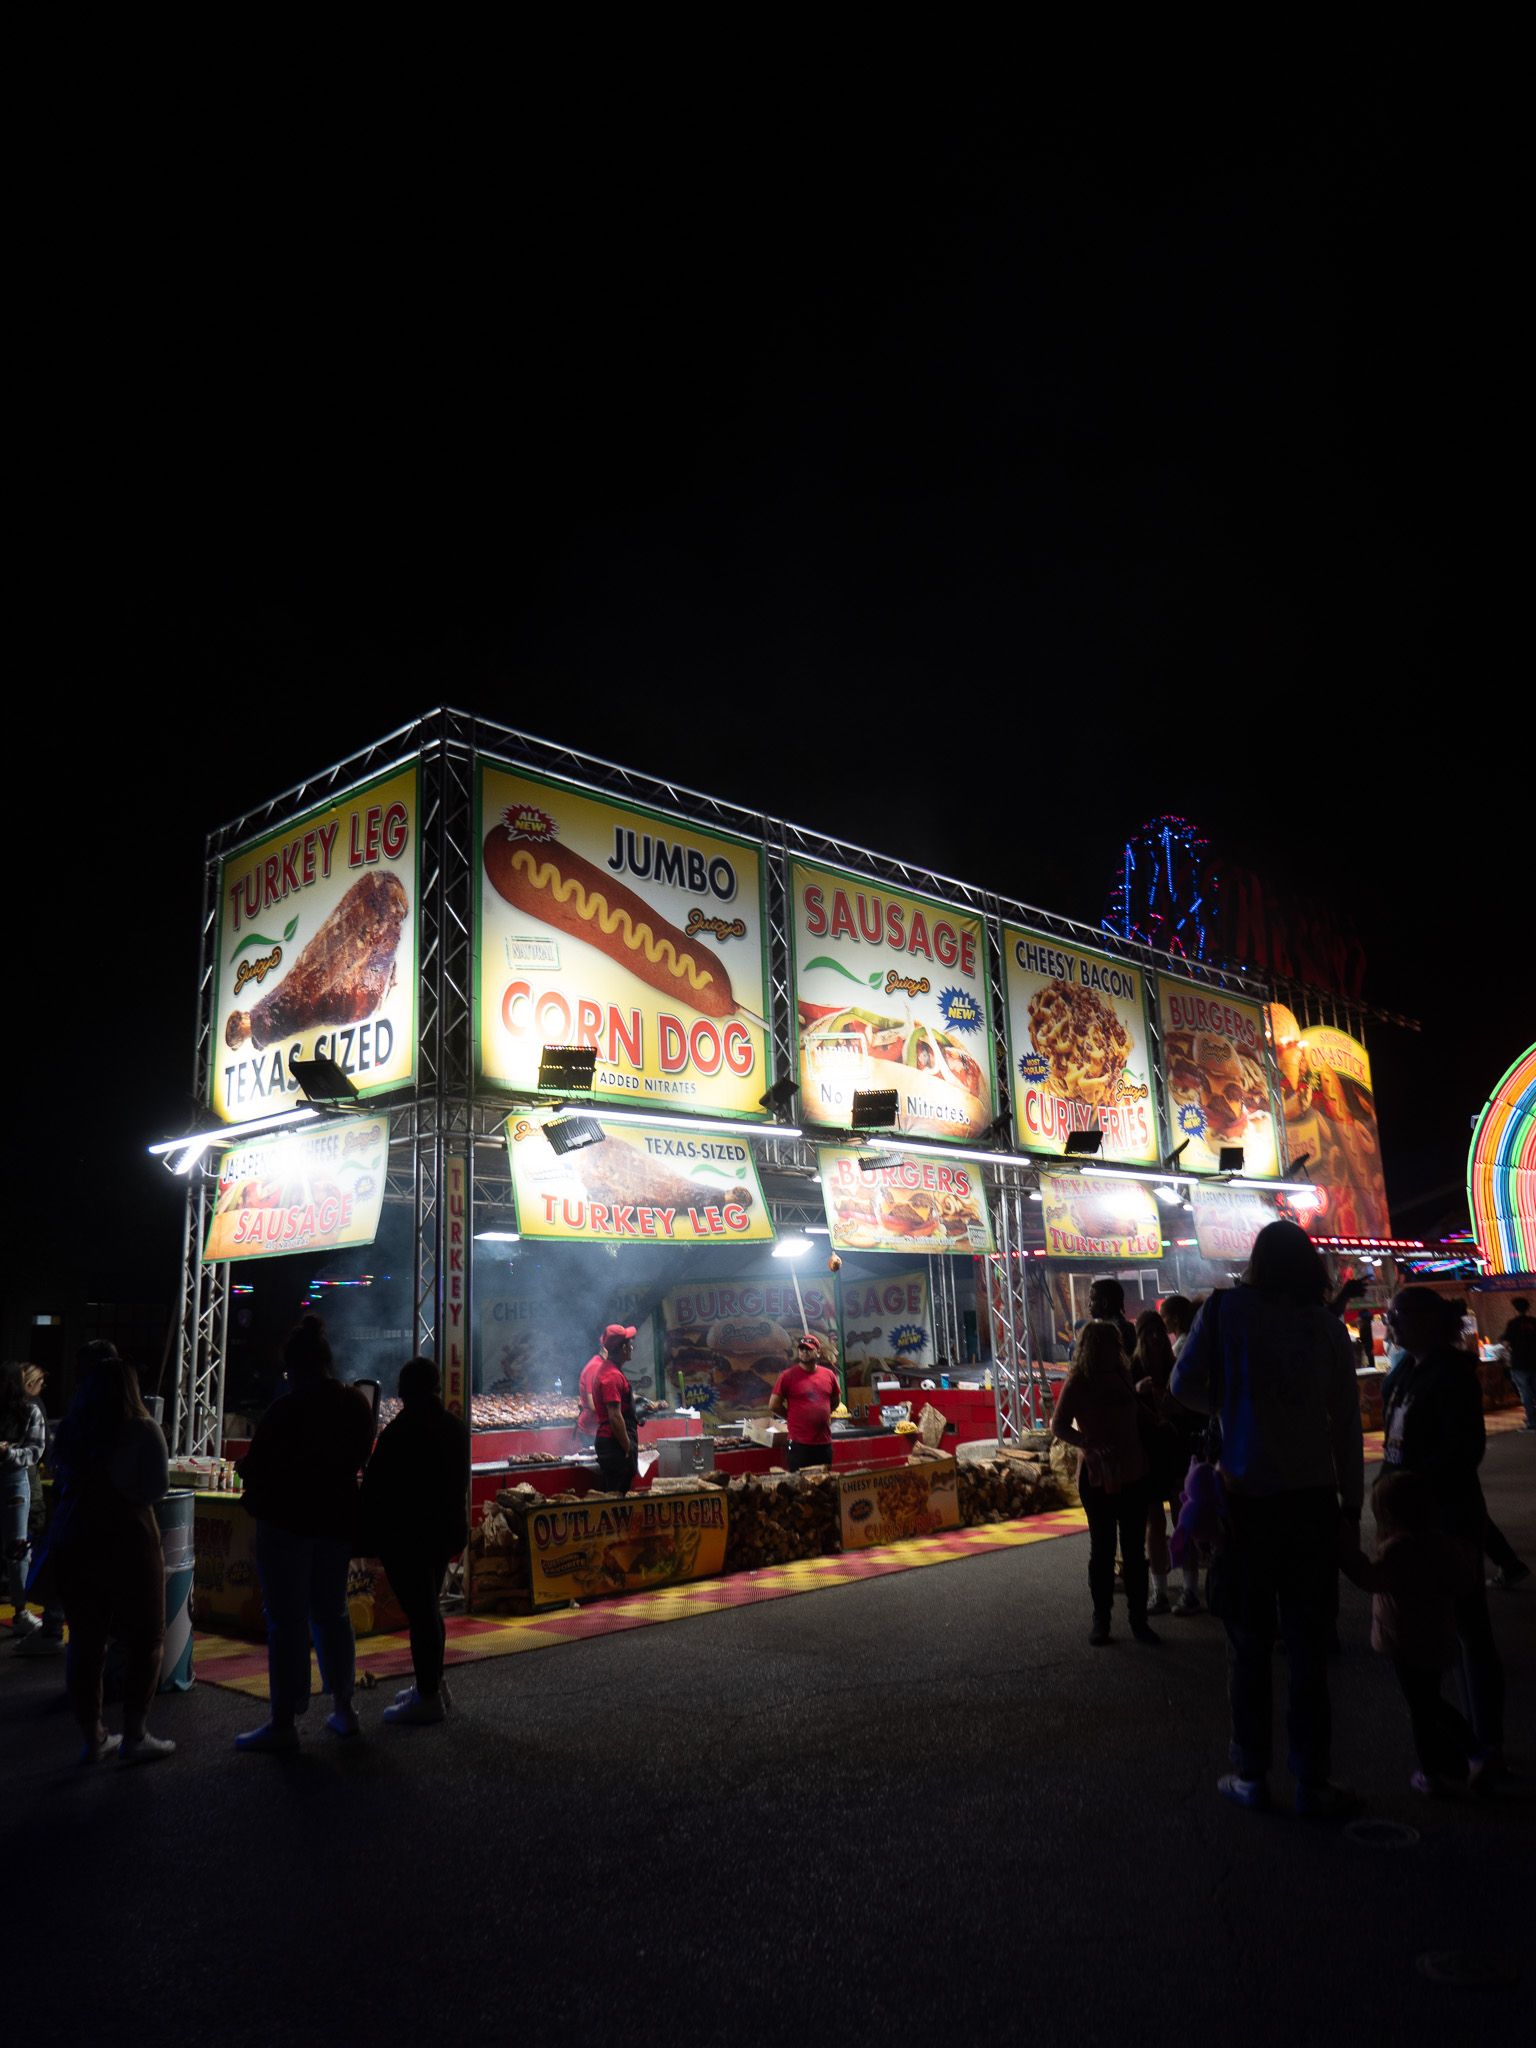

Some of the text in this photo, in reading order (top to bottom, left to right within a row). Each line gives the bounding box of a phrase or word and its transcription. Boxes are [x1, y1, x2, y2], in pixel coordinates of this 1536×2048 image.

[515, 820, 546, 832] NEW!
[518, 810, 541, 822] ALL
[229, 801, 408, 931] TURKEY LEG
[607, 825, 738, 903] JUMBO
[803, 885, 976, 979] SAUSAGE
[1015, 940, 1135, 1001] CHEESY BACON
[948, 1006, 976, 1021] NEW!
[951, 996, 971, 1008] ALL
[1168, 994, 1256, 1048] BURGERS
[501, 979, 754, 1077] CORN DOG
[225, 1042, 303, 1107] TEXAS
[599, 1071, 697, 1095] ADDED NITRATES
[820, 1083, 843, 1105] No
[1097, 1105, 1149, 1149] FRIES
[644, 1137, 746, 1161] TEXAS-SIZED
[837, 1159, 970, 1199] BURGERS
[233, 1193, 354, 1242] SAUSAGE
[541, 1193, 750, 1237] TURKEY LEG
[450, 1167, 463, 1327] TURKEY
[1049, 1226, 1160, 1255] TURKEY LEG
[1212, 1228, 1256, 1249] SAUSA
[675, 1286, 823, 1323] BURGERS
[847, 1283, 922, 1318] SAGE
[533, 1498, 724, 1549] OUTLAW BURGER
